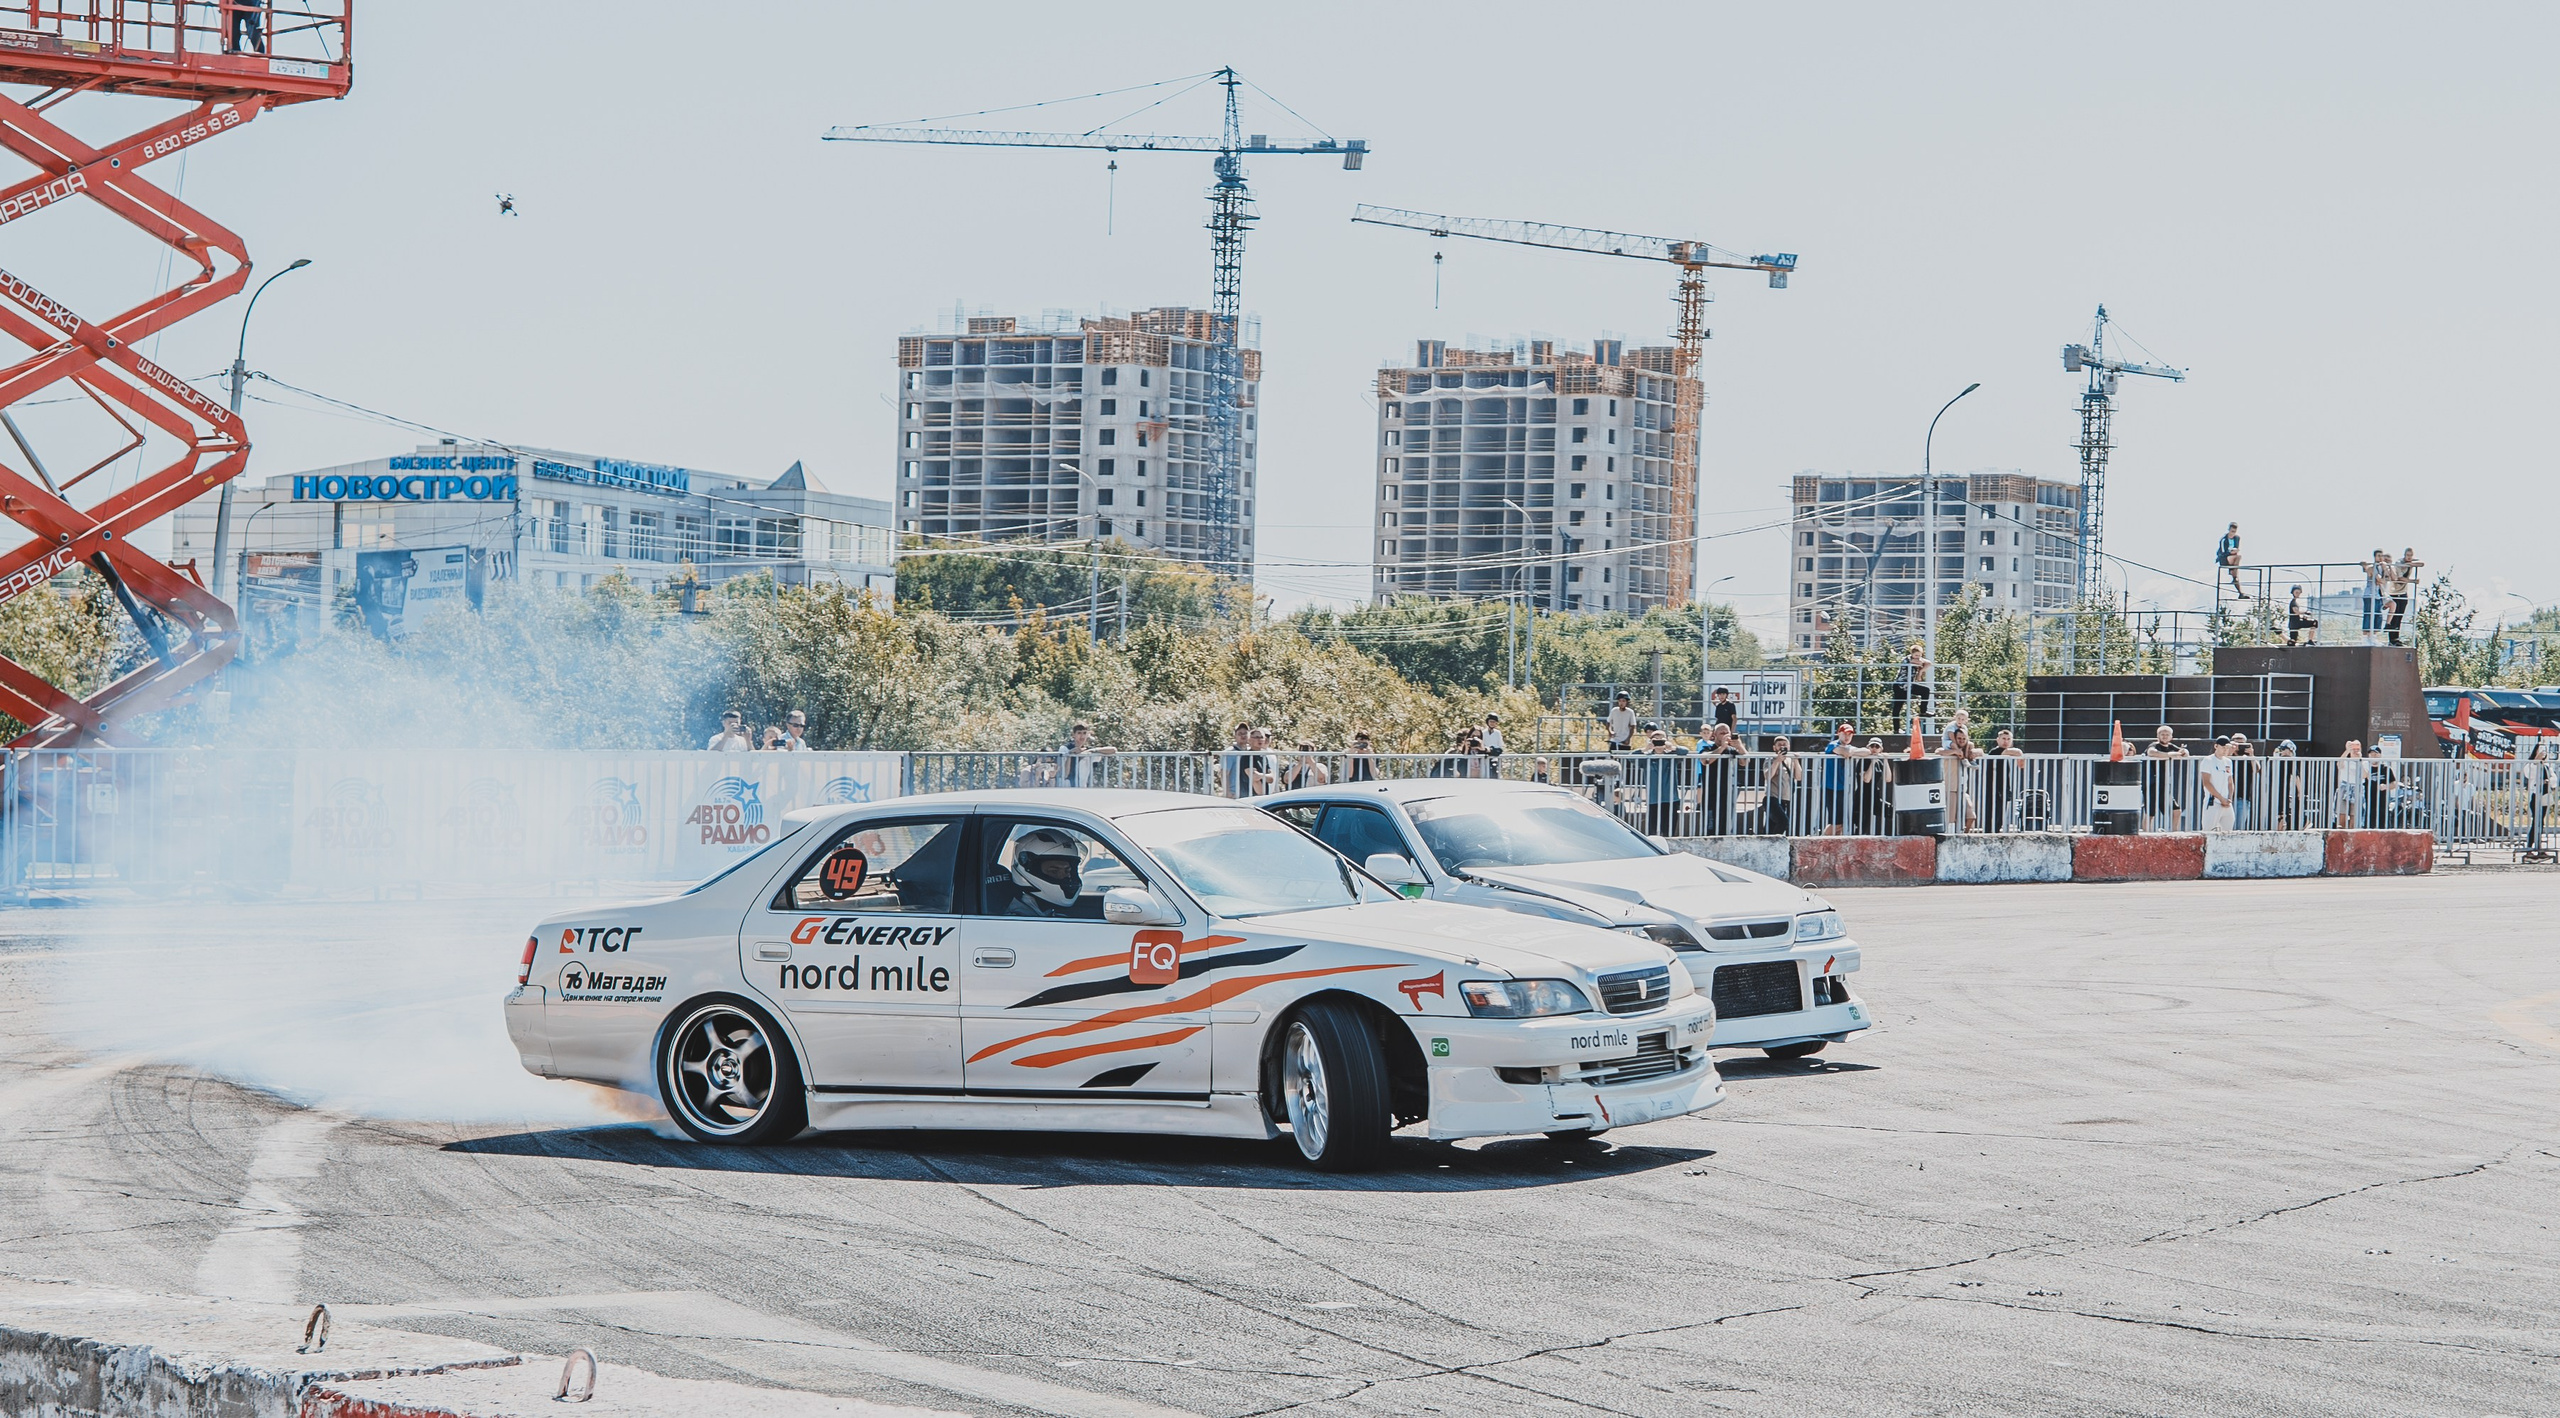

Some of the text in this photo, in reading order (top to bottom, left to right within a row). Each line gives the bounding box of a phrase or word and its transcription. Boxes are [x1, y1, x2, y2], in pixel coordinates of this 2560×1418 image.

[143, 109, 240, 158] 8 800 555 19 28
[0, 268, 82, 334] РОДАЖА
[136, 357, 230, 423] WWW.ARLIFT.RU
[389, 456, 516, 473] БИЗНЕС-ЦЕНТР
[293, 473, 518, 500] НОВОСТРОЙ
[0, 547, 76, 604] ЕРВИС
[1751, 701, 1785, 716] ЦНТР
[685, 804, 741, 824] АВТО
[701, 824, 770, 844] РАДИО
[827, 858, 863, 890] 49
[587, 926, 643, 953] ТСГ
[1133, 942, 1176, 970] FQ
[587, 971, 667, 993] Магадан
[779, 954, 950, 992] nord mile
[563, 993, 603, 1002] Движение
[614, 995, 662, 1004] опережение
[1432, 1042, 1449, 1053] FQ
[1571, 1028, 1628, 1049] nord mile
